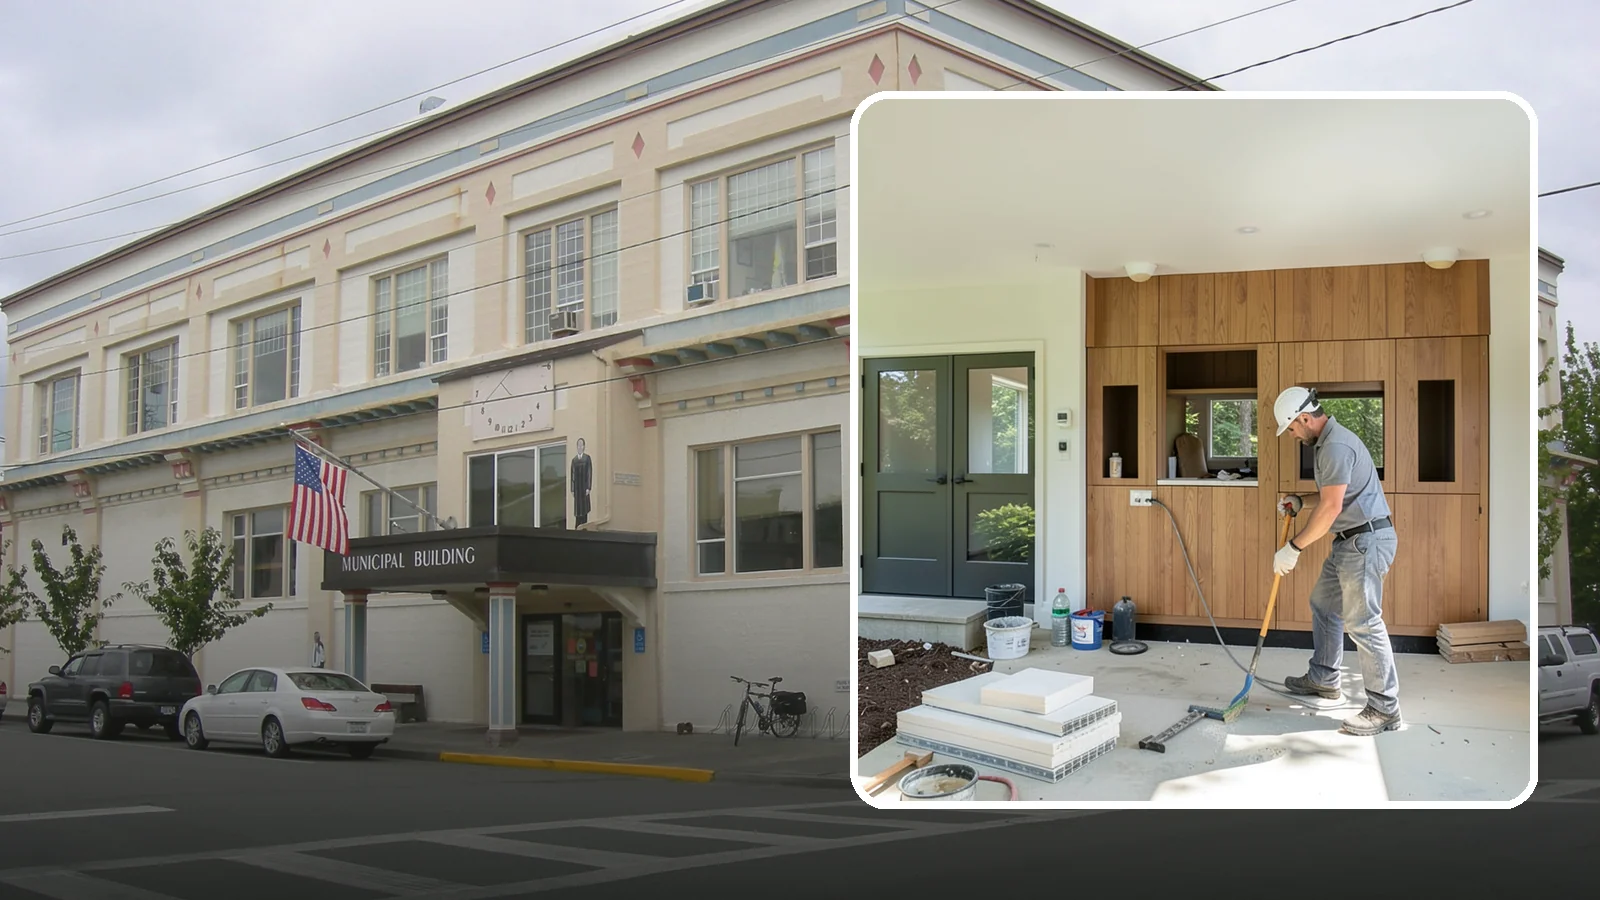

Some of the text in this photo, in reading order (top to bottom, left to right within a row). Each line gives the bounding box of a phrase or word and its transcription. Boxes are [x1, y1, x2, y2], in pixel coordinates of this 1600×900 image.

[494, 424, 500, 432] 10
[507, 425, 513, 433] 12
[521, 420, 525, 428] 2
[528, 414, 533, 422] 3
[342, 546, 475, 572] MUNICIPAL BUILDING
